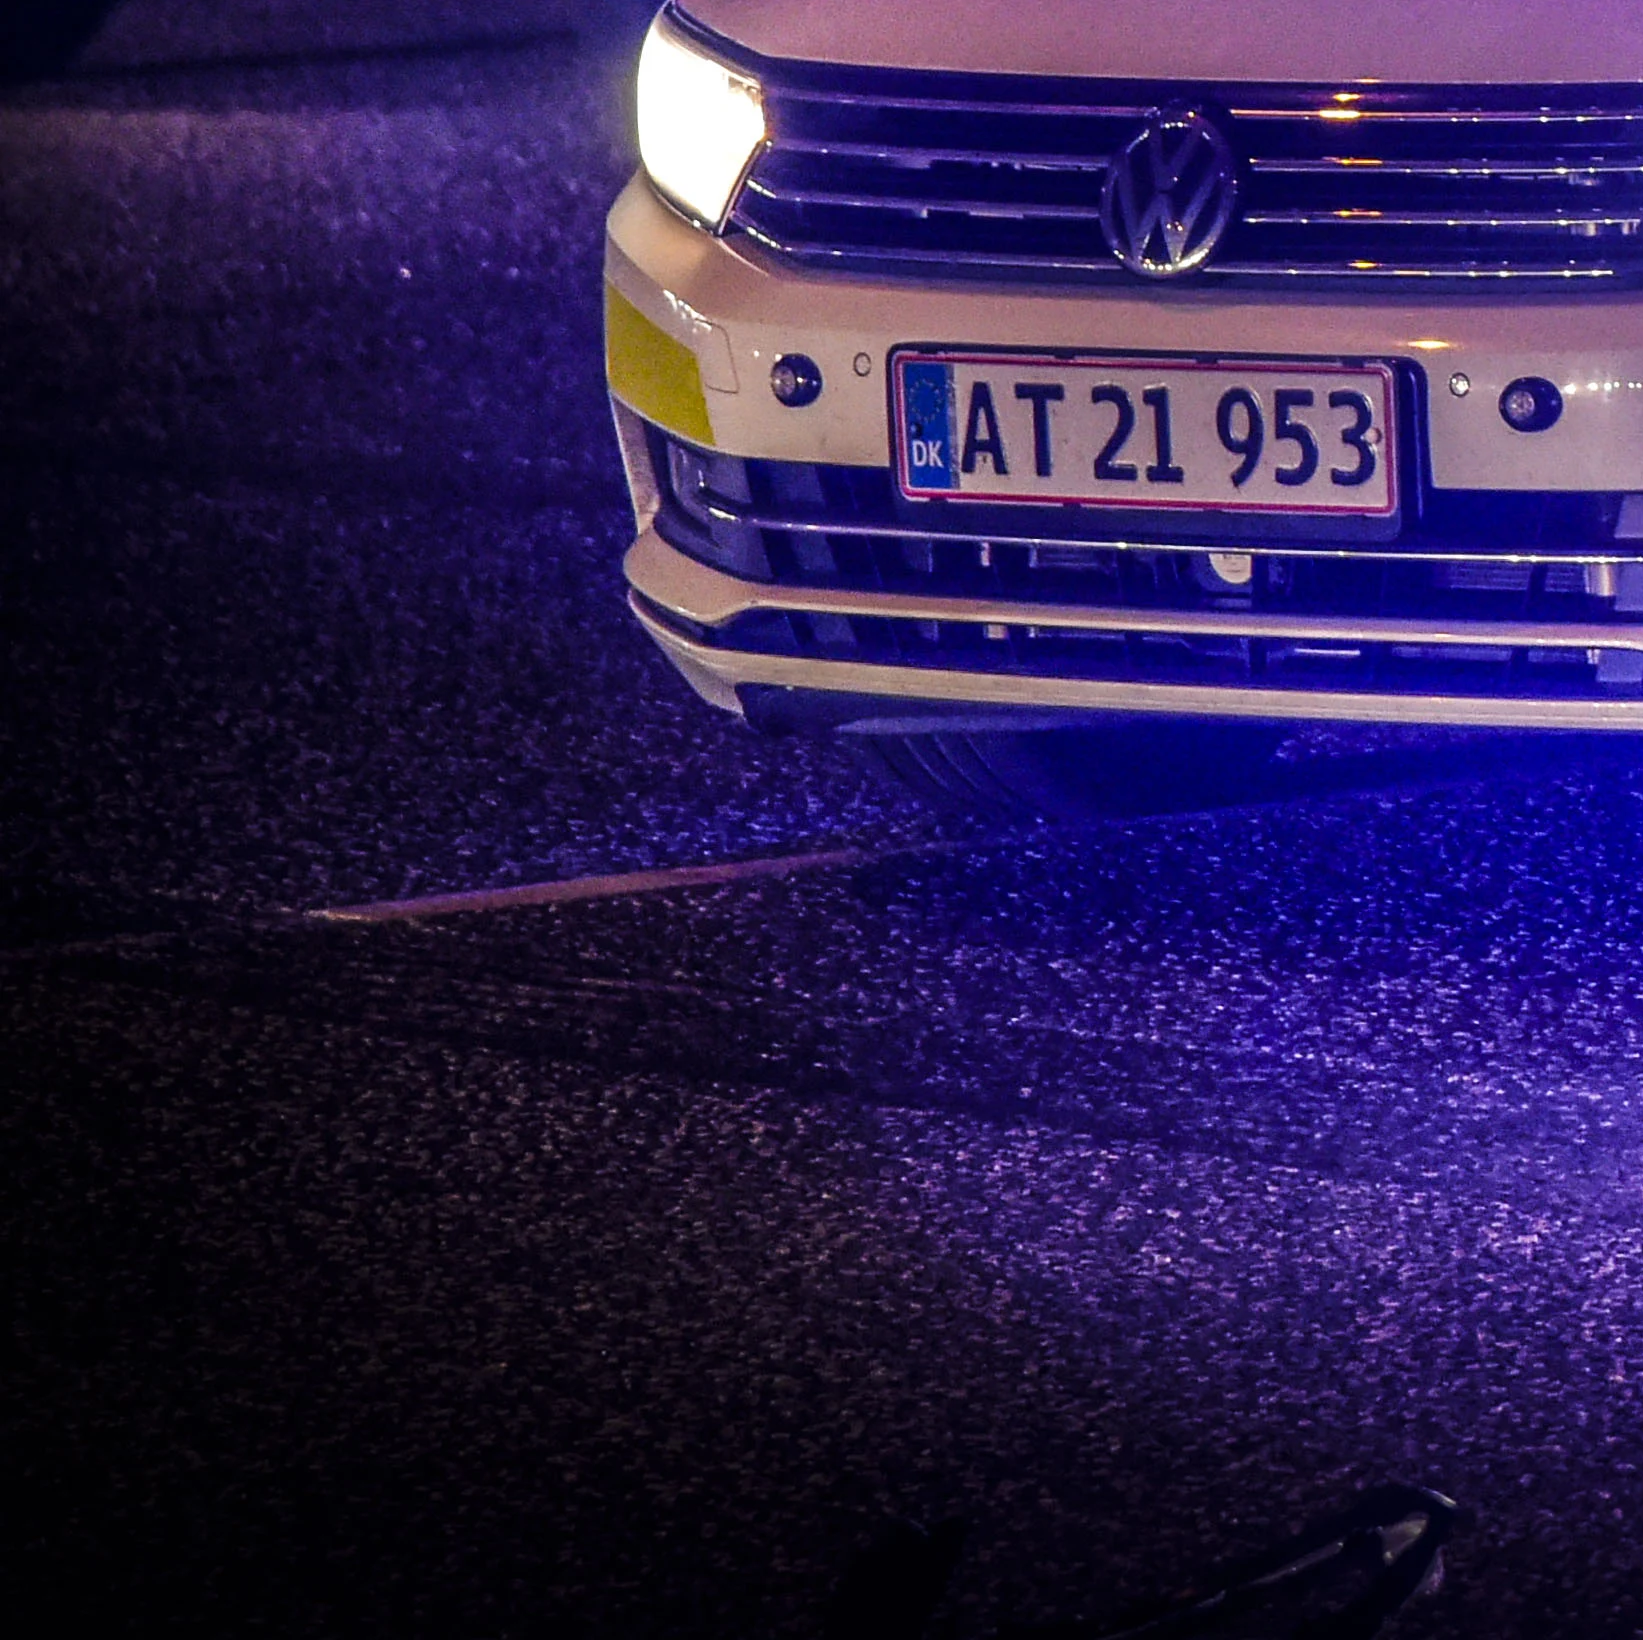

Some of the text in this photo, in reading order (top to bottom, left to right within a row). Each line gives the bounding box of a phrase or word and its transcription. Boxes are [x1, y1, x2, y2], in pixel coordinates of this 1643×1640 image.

[911, 439, 945, 469] DK
[960, 381, 1378, 489] AT 21 953
